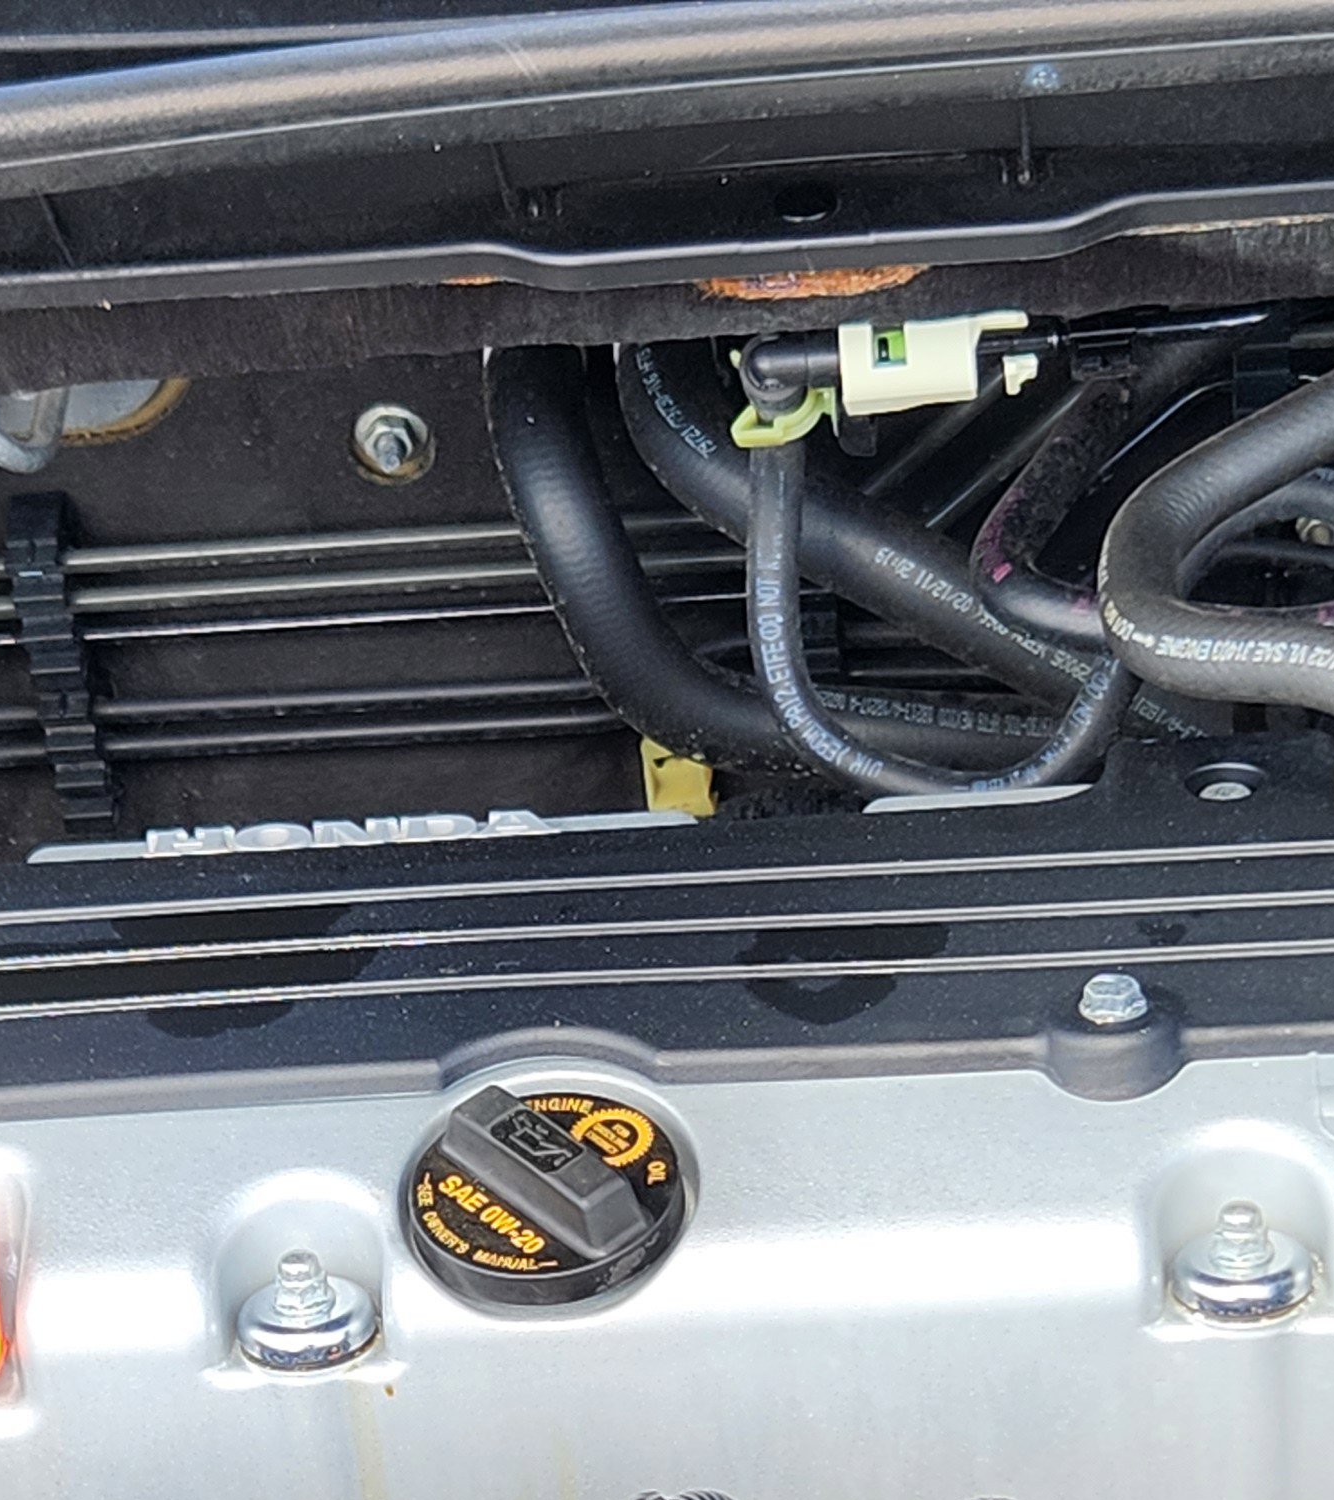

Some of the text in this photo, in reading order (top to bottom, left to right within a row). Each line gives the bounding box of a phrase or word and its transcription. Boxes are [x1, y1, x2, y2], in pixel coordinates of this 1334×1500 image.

[1249, 644, 1289, 664] SAE
[143, 809, 562, 858] HONDA
[646, 1160, 667, 1186] OIL
[437, 1174, 546, 1255] SAE 0W-20
